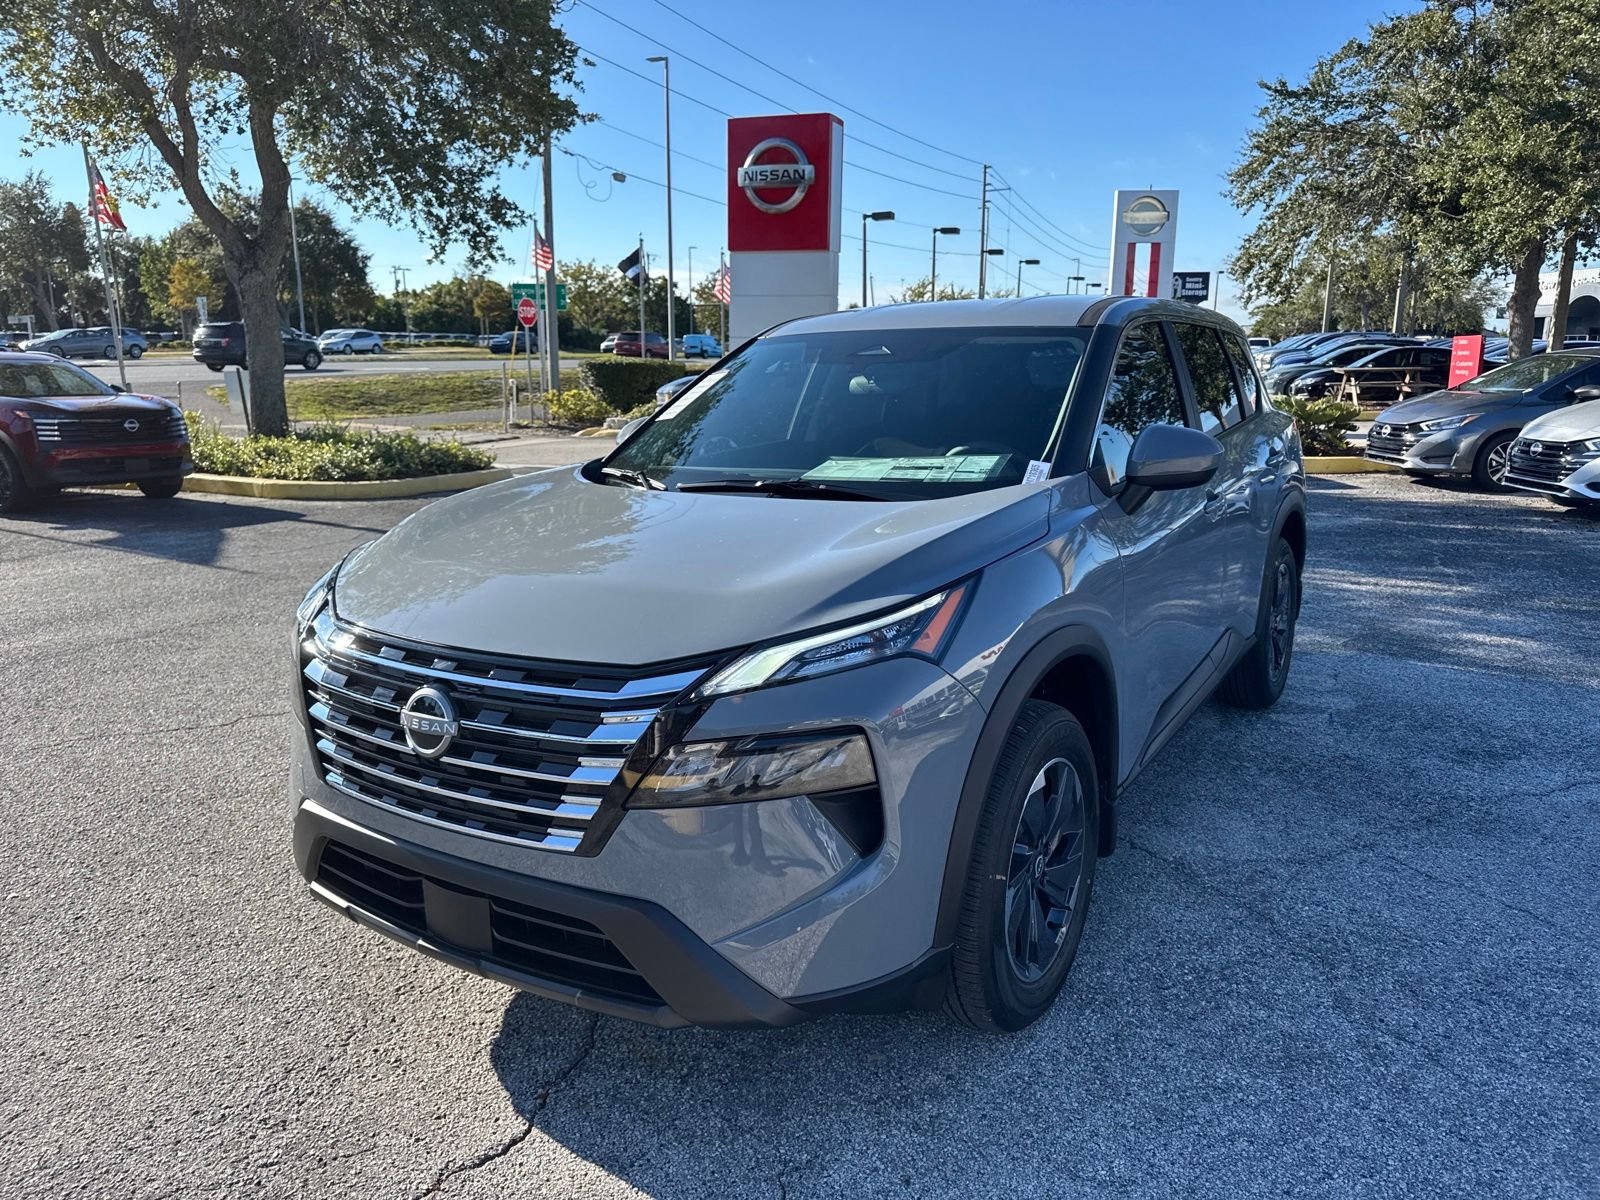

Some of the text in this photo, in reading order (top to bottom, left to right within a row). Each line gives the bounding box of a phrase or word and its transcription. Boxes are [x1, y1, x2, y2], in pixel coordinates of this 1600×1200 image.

[743, 168, 806, 182] NISSAN
[520, 307, 536, 318] STOP
[401, 712, 456, 734] NISSAN
